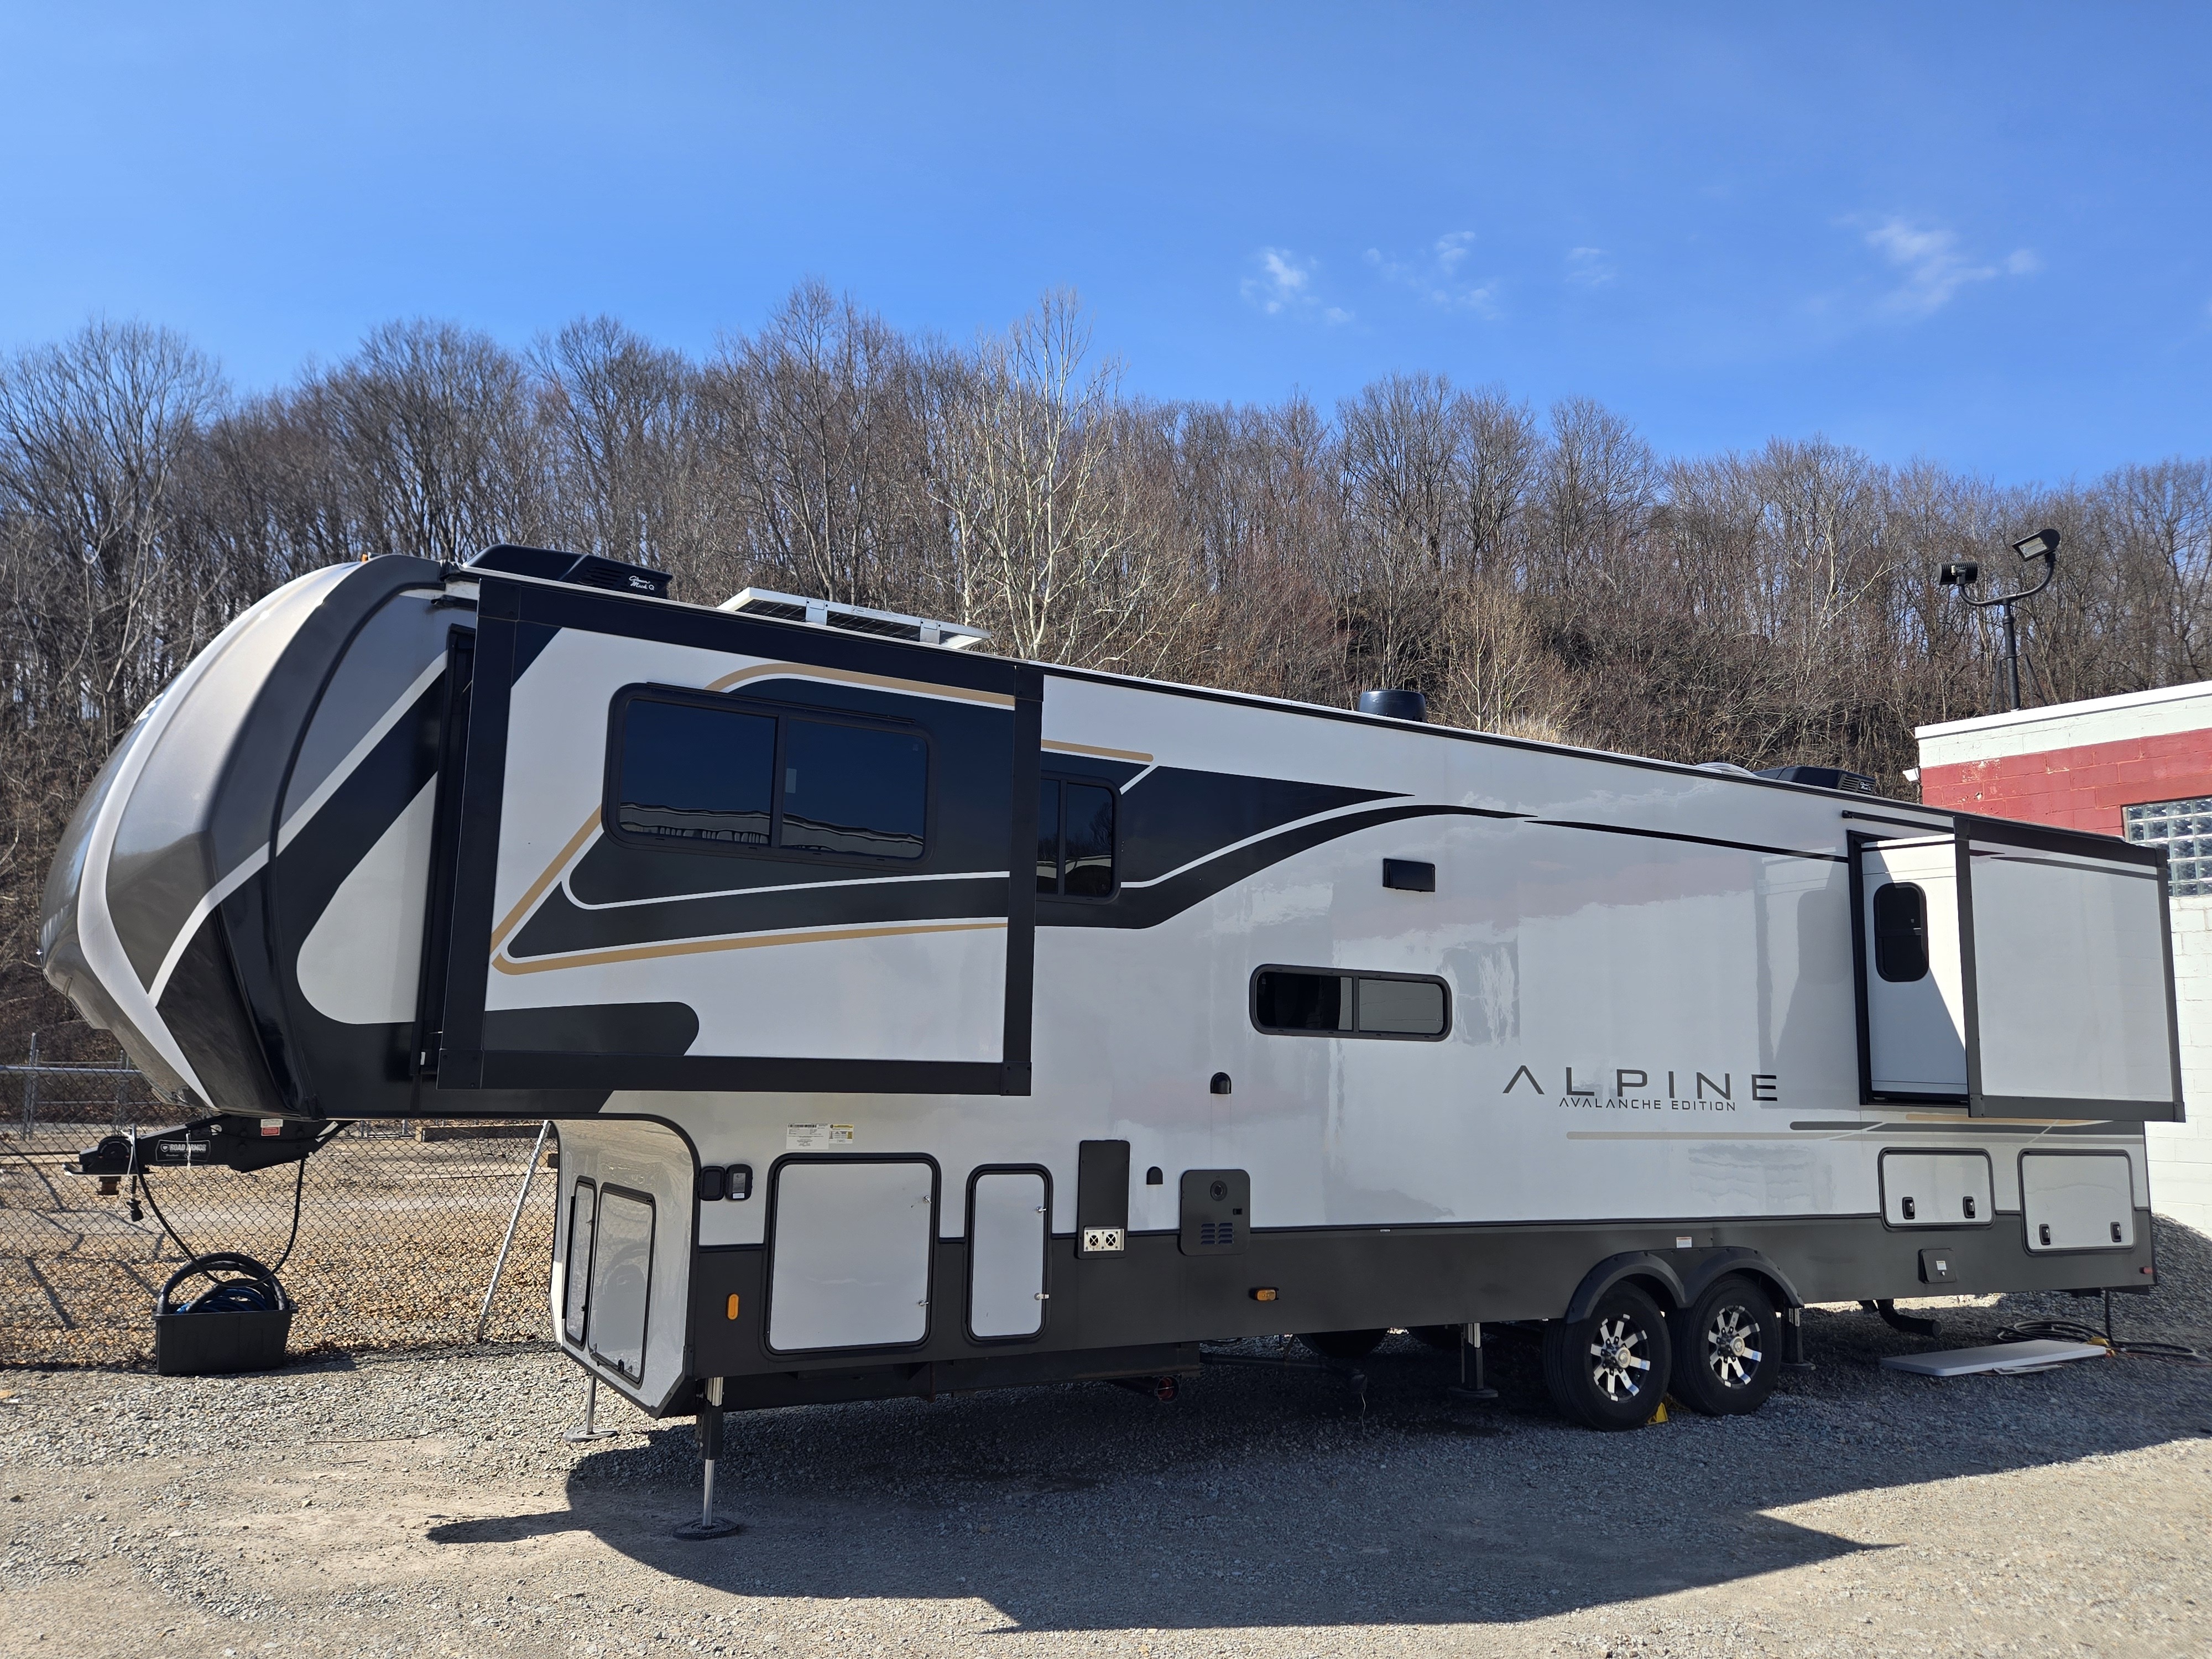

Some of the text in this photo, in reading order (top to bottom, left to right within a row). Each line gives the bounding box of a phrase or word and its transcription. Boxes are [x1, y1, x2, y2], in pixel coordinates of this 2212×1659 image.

[1503, 1065, 1778, 1102] ALPINE
[1559, 1097, 1735, 1111] AVALANCHE EDITION
